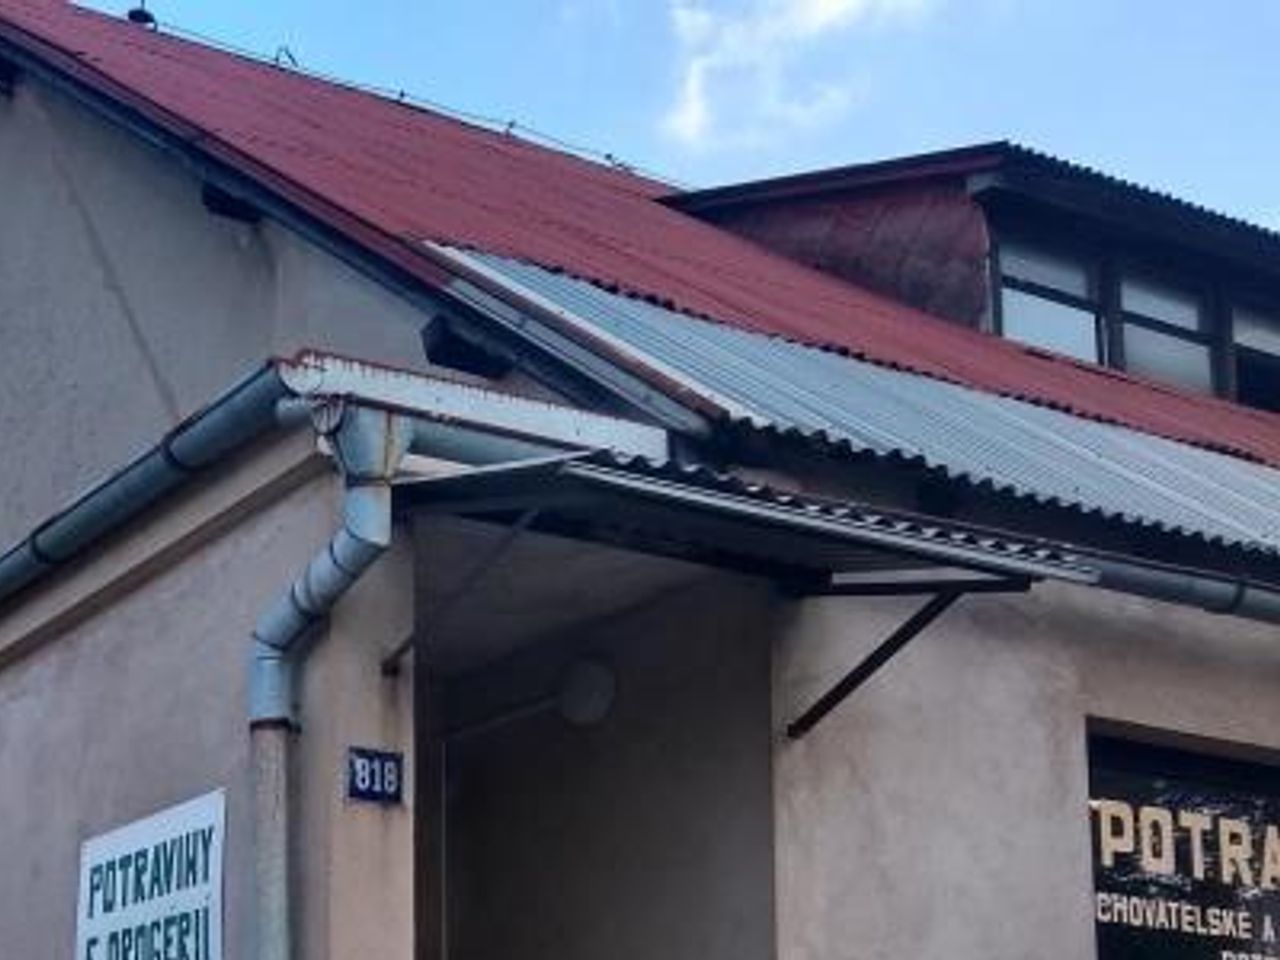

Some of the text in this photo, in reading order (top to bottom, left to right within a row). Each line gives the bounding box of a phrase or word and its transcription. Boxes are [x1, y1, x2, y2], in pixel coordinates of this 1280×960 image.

[355, 758, 398, 793] 818
[87, 826, 214, 919] POTRAVINY
[1096, 800, 1280, 890] POTRA
[1261, 914, 1277, 942] A
